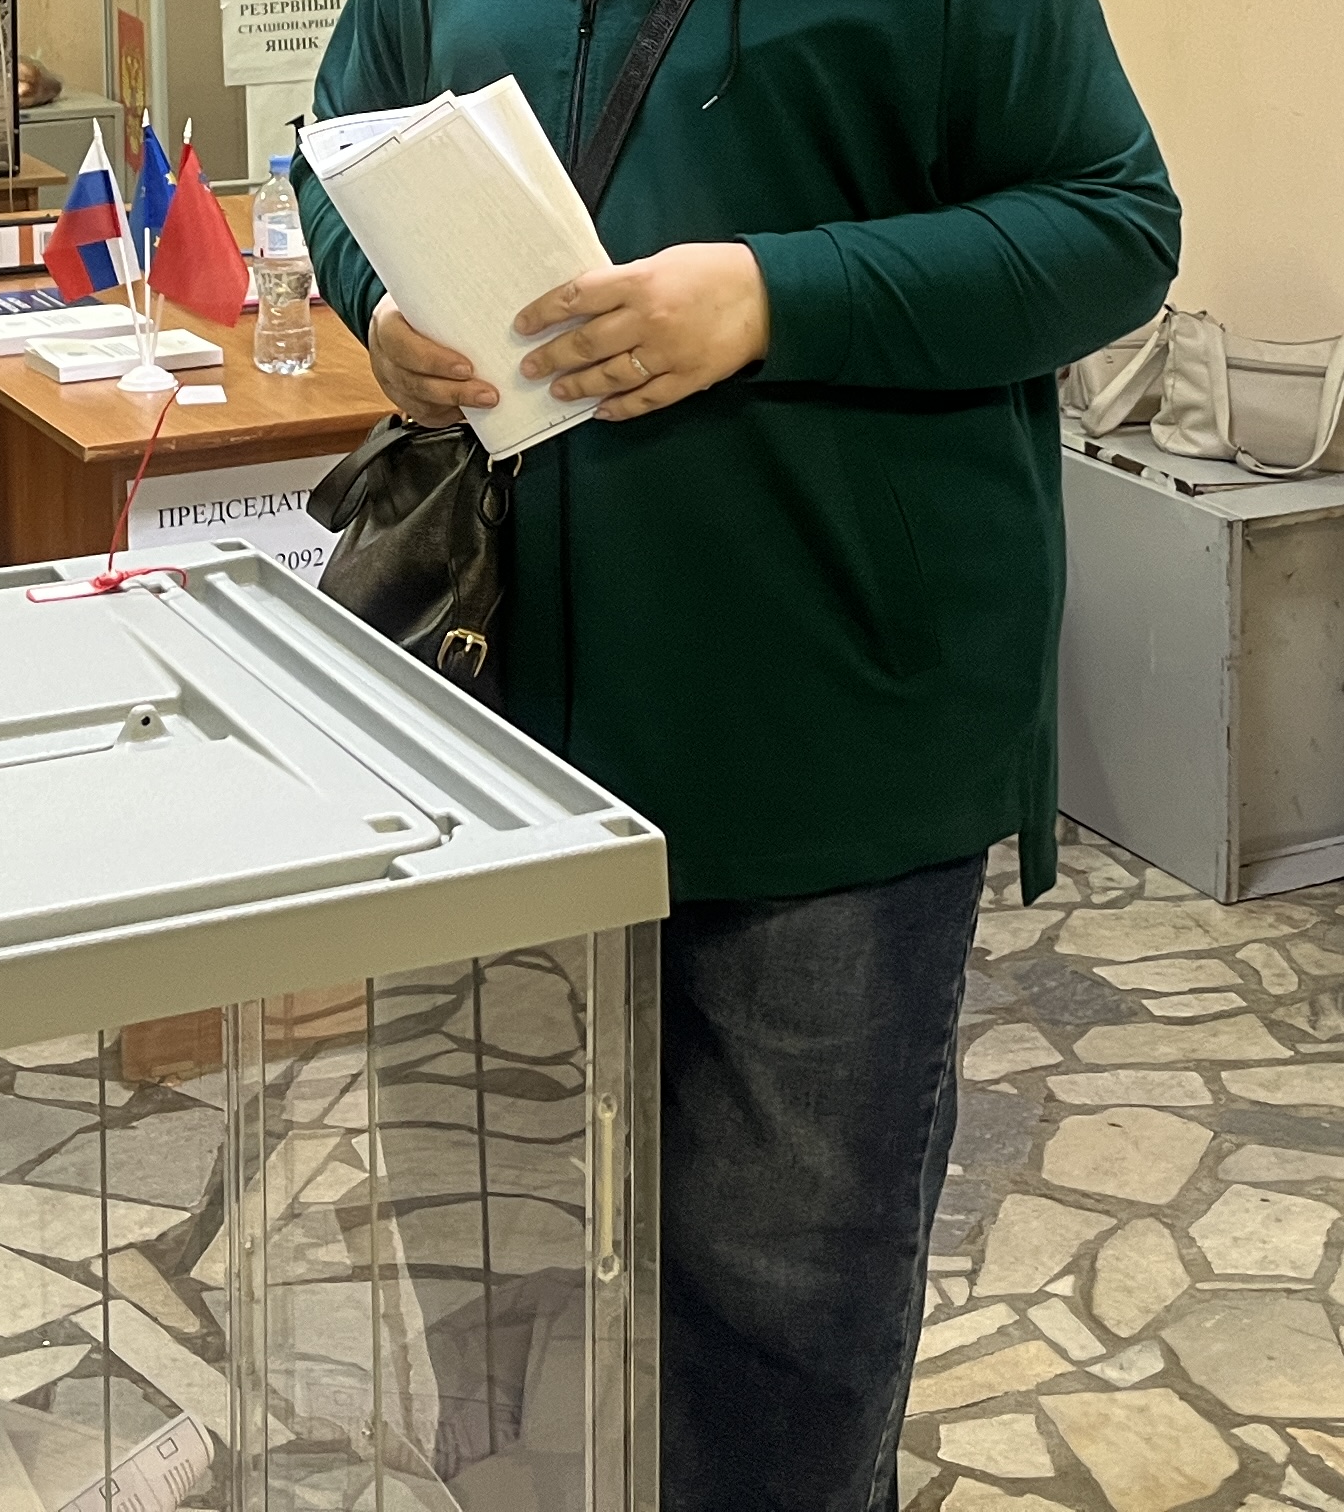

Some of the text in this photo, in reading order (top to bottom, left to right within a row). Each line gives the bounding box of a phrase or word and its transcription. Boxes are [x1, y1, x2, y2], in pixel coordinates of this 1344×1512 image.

[237, 18, 337, 34] СТАЦИОНАРНЫ
[265, 36, 319, 53] ЯЩИК
[158, 488, 313, 529] ПРЕДСЕДАТ
